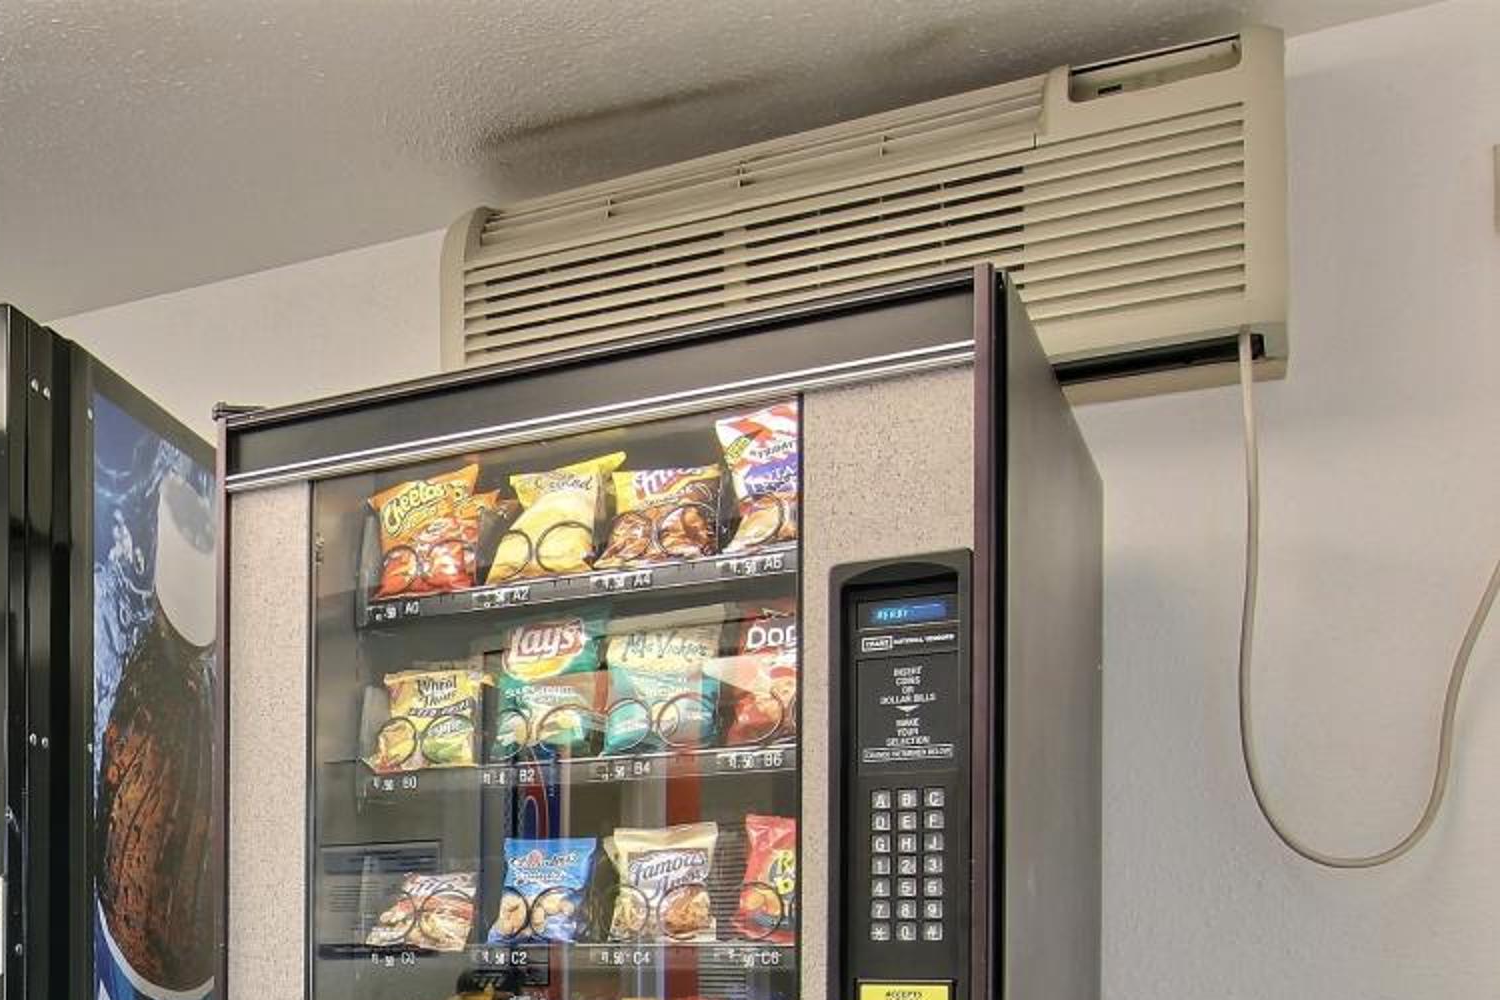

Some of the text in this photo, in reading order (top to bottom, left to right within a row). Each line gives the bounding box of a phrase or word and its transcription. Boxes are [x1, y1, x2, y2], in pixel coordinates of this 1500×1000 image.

[383, 482, 449, 536] Cheetos
[633, 574, 651, 586] A4
[513, 588, 530, 600] A2
[895, 676, 921, 687] COINS
[902, 686, 915, 695] OR
[879, 692, 938, 705] DOLLAR BILLS
[895, 717, 920, 727] MAKE
[897, 727, 920, 737] YOUR
[885, 736, 931, 747] SELECTION
[634, 761, 651, 774] B4
[519, 769, 535, 782] B2
[629, 850, 708, 887] Famous
[511, 951, 528, 965] C2
[633, 951, 651, 965] C4
[885, 990, 923, 1000] ACCEPTS
